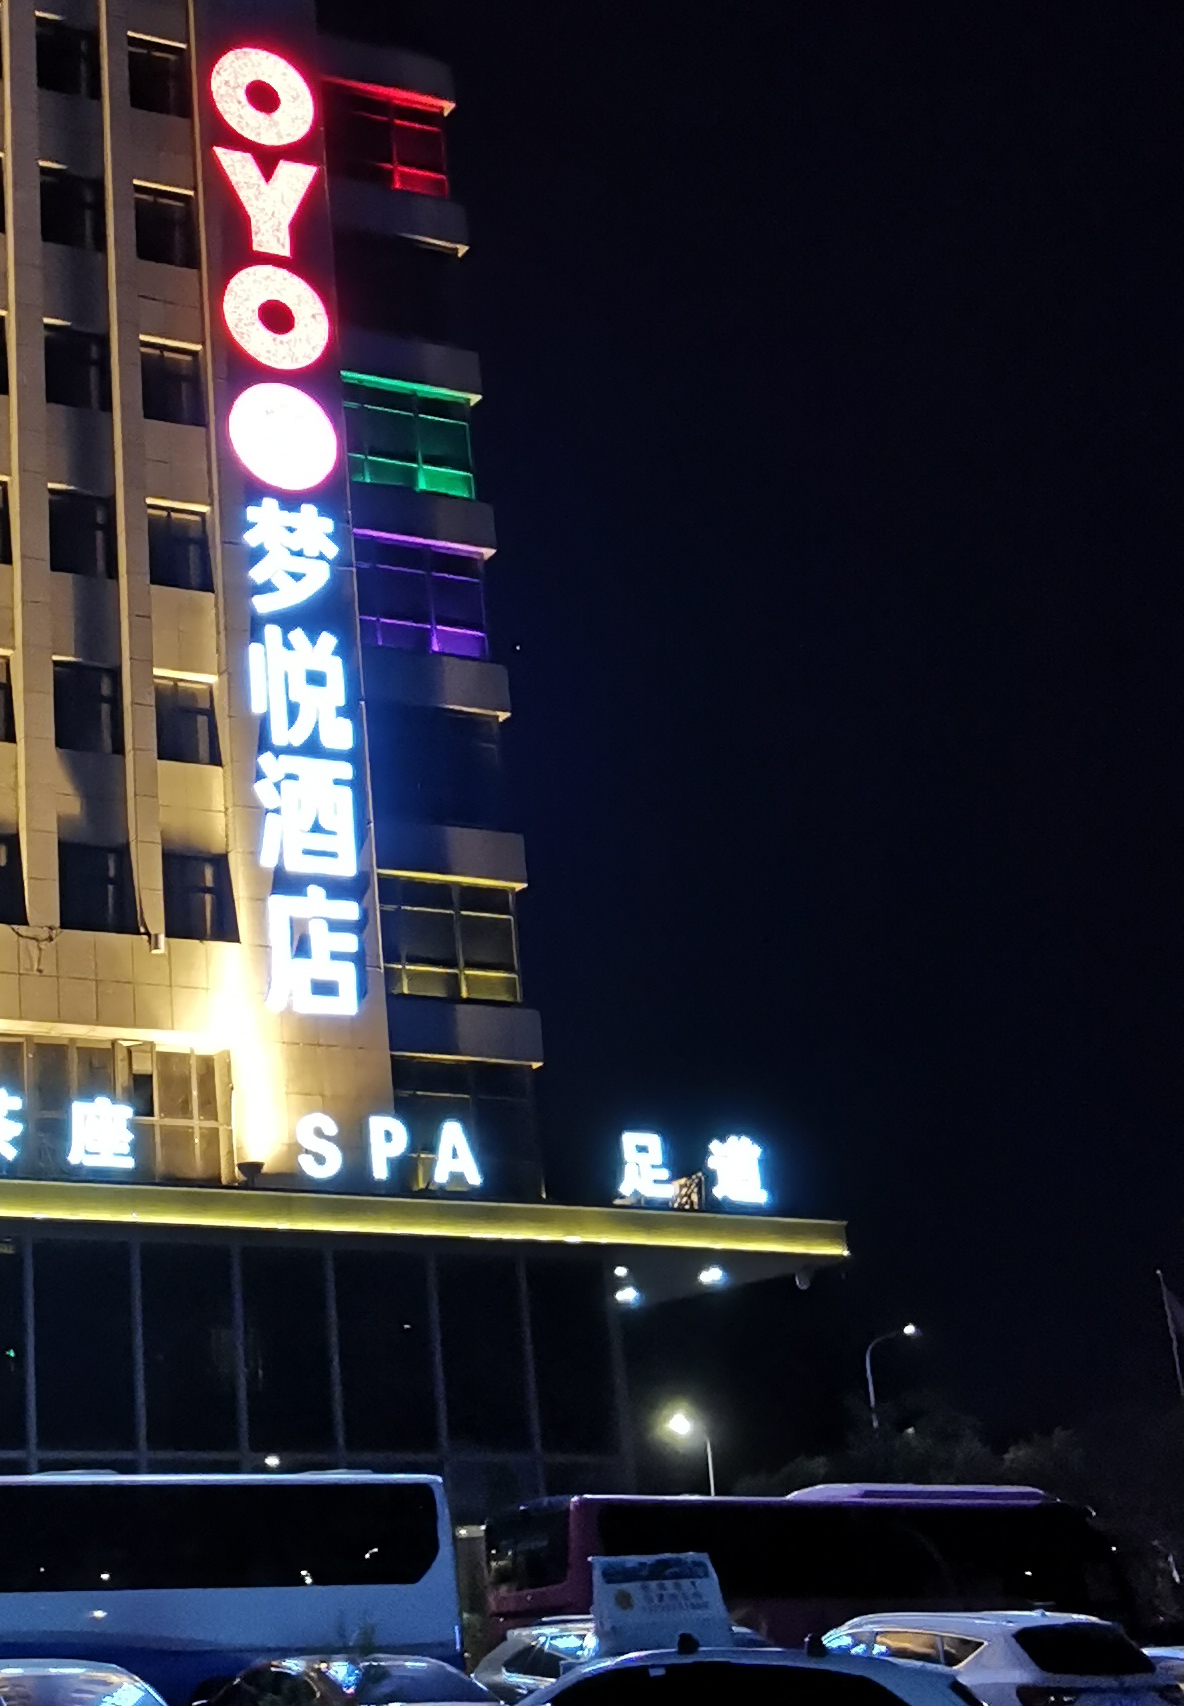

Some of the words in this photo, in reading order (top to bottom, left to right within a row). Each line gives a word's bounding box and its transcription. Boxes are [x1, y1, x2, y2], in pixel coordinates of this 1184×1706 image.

[210, 46, 330, 371] OYO
[242, 496, 361, 1017] 梦悦酒店
[294, 1111, 483, 1187] SPA
